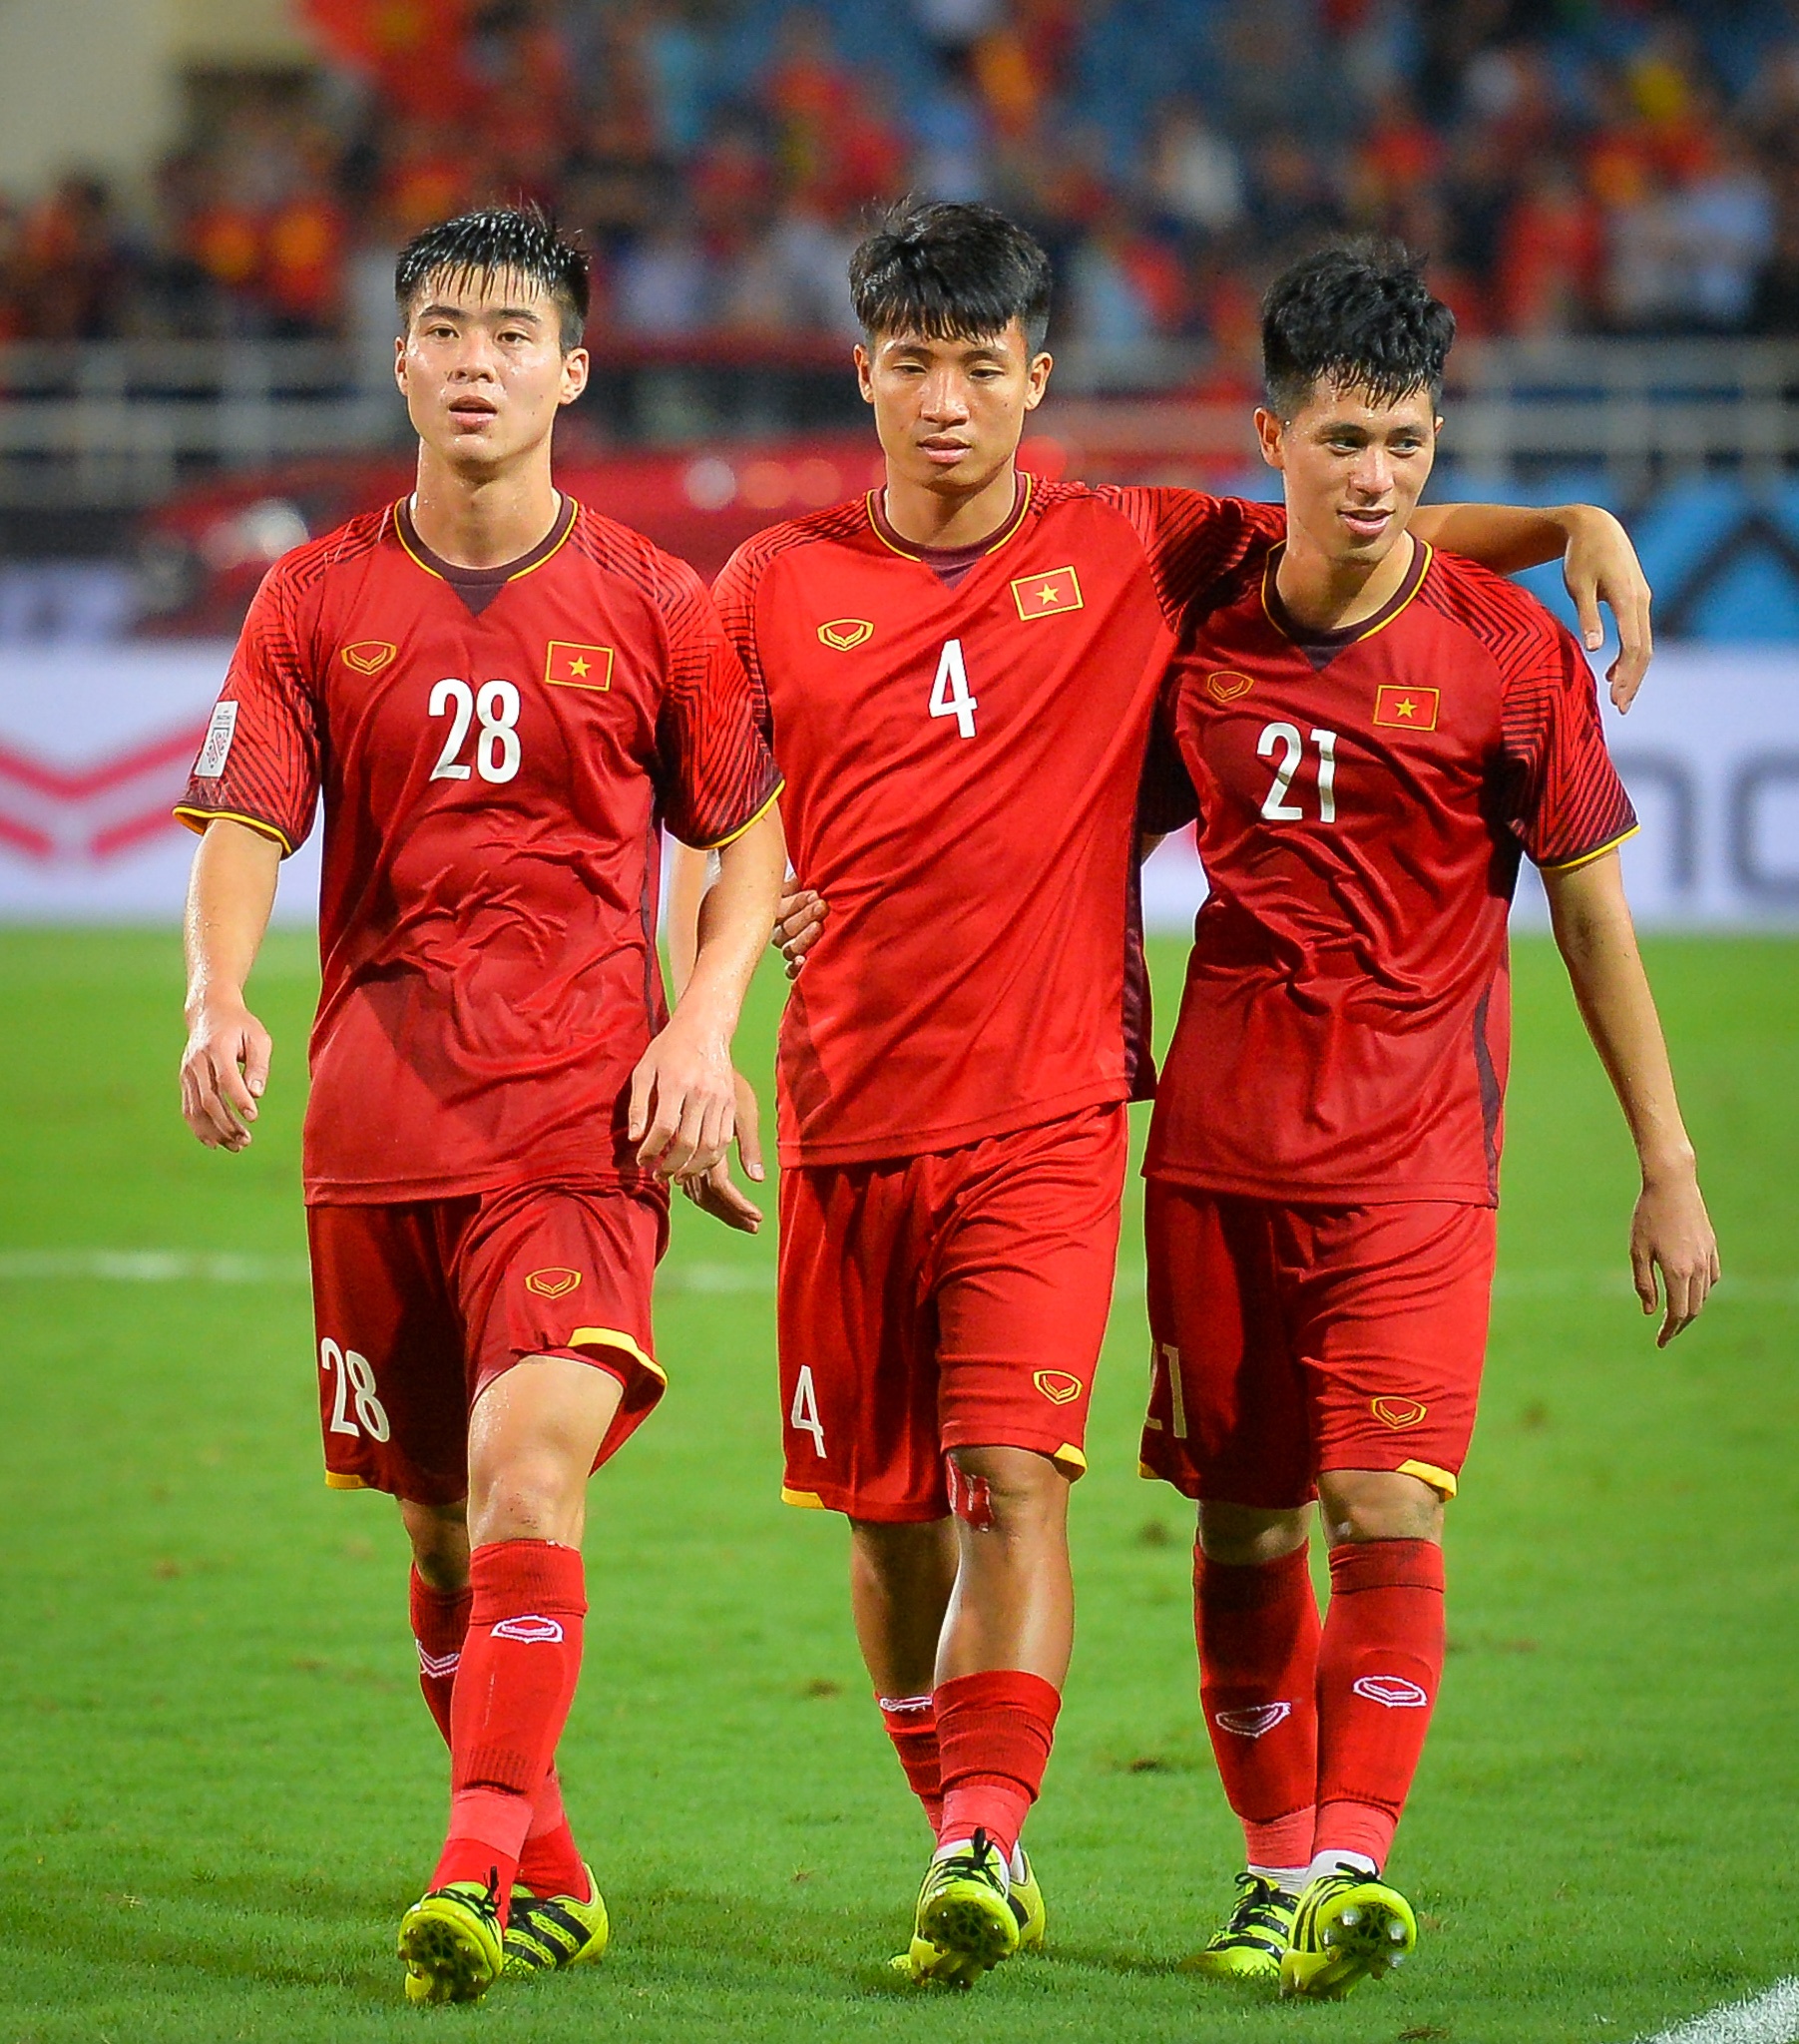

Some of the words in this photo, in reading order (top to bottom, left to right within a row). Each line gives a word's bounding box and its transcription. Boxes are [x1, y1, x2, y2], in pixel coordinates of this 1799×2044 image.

[428, 678, 522, 784] 28
[929, 639, 978, 739] 4
[1256, 722, 1338, 823] 21
[320, 1336, 390, 1443] 28
[790, 1364, 827, 1459] 4
